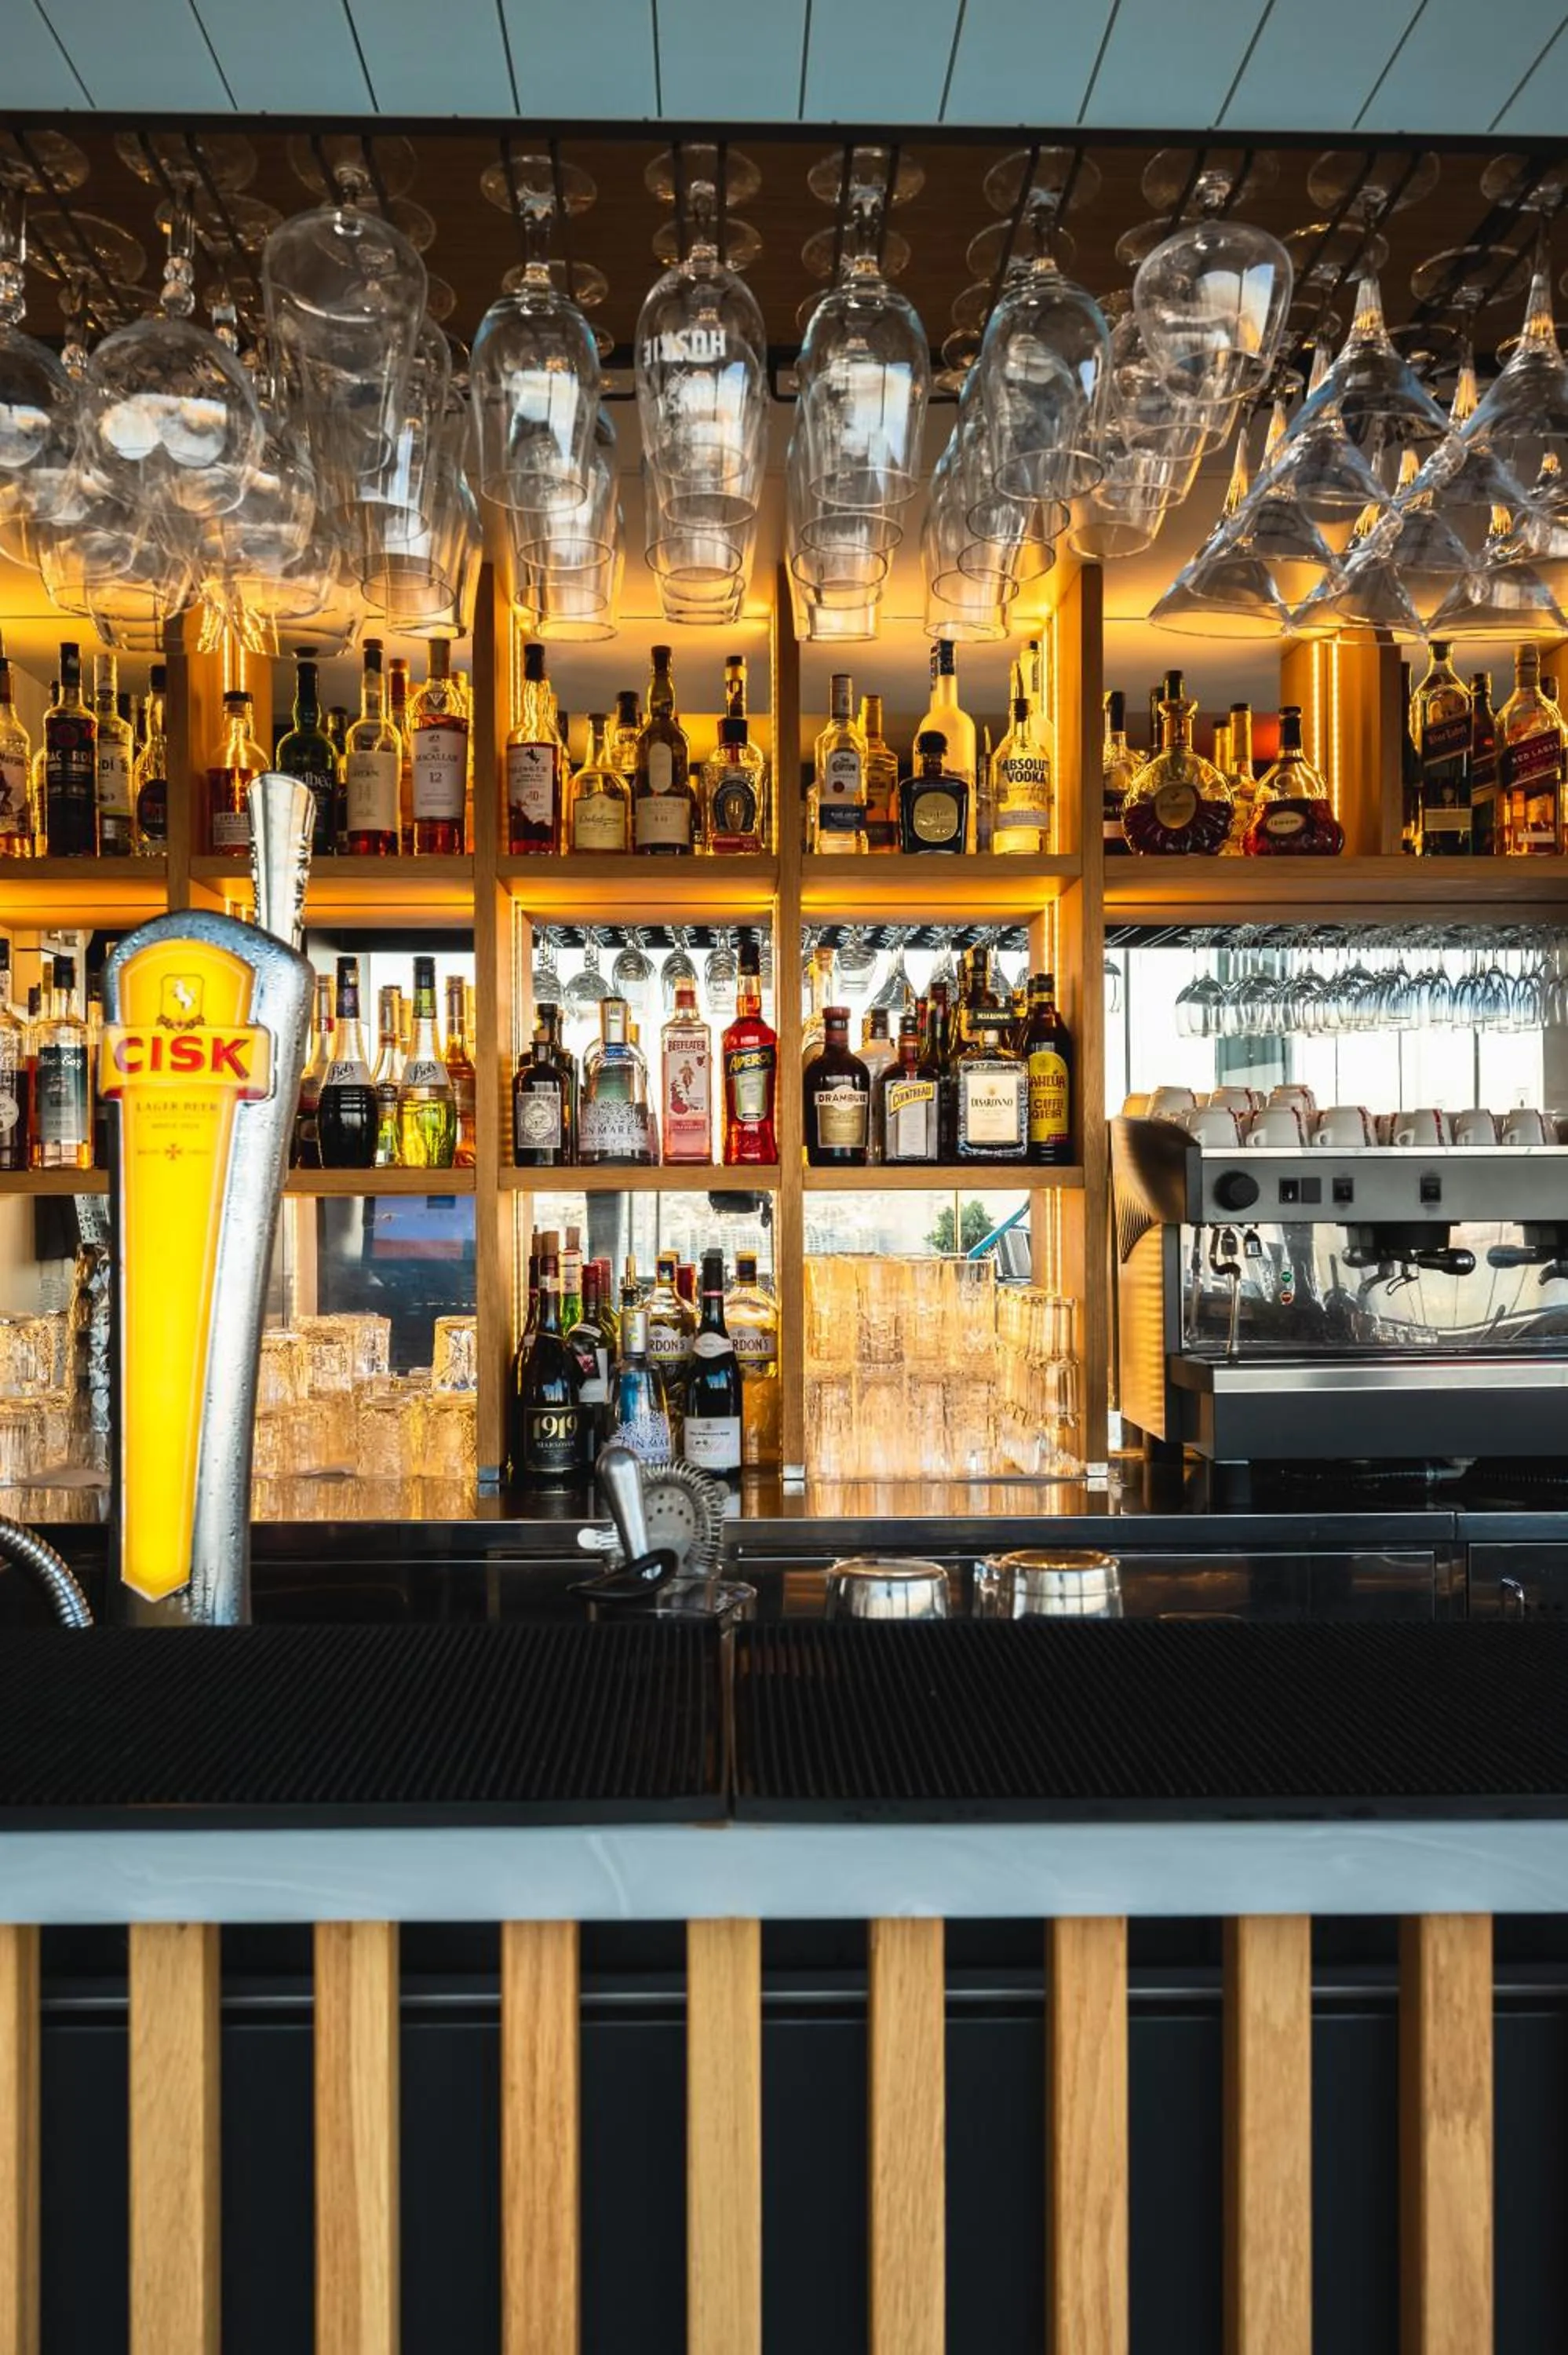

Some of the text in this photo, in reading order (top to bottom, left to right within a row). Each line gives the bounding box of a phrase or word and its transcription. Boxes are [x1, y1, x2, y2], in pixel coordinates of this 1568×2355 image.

[47, 750, 93, 762] ACRDI
[1511, 742, 1559, 765] RED LABEL
[428, 772, 443, 783] 12
[1007, 770, 1047, 783] VODKA
[668, 1039, 706, 1053] BEEFEATER
[114, 1035, 251, 1081] CISK
[1029, 1069, 1066, 1088] AHLÚA
[818, 1094, 866, 1103] DRAMBUIE
[892, 1085, 932, 1108] COINTREAU
[971, 1097, 1013, 1108] DISARONNO
[136, 1101, 218, 1112] LAGER BEER
[599, 1125, 632, 1135] MARE
[650, 1339, 685, 1352] RDON'S
[732, 1337, 769, 1352] RDON'S
[533, 1415, 578, 1440] 1919
